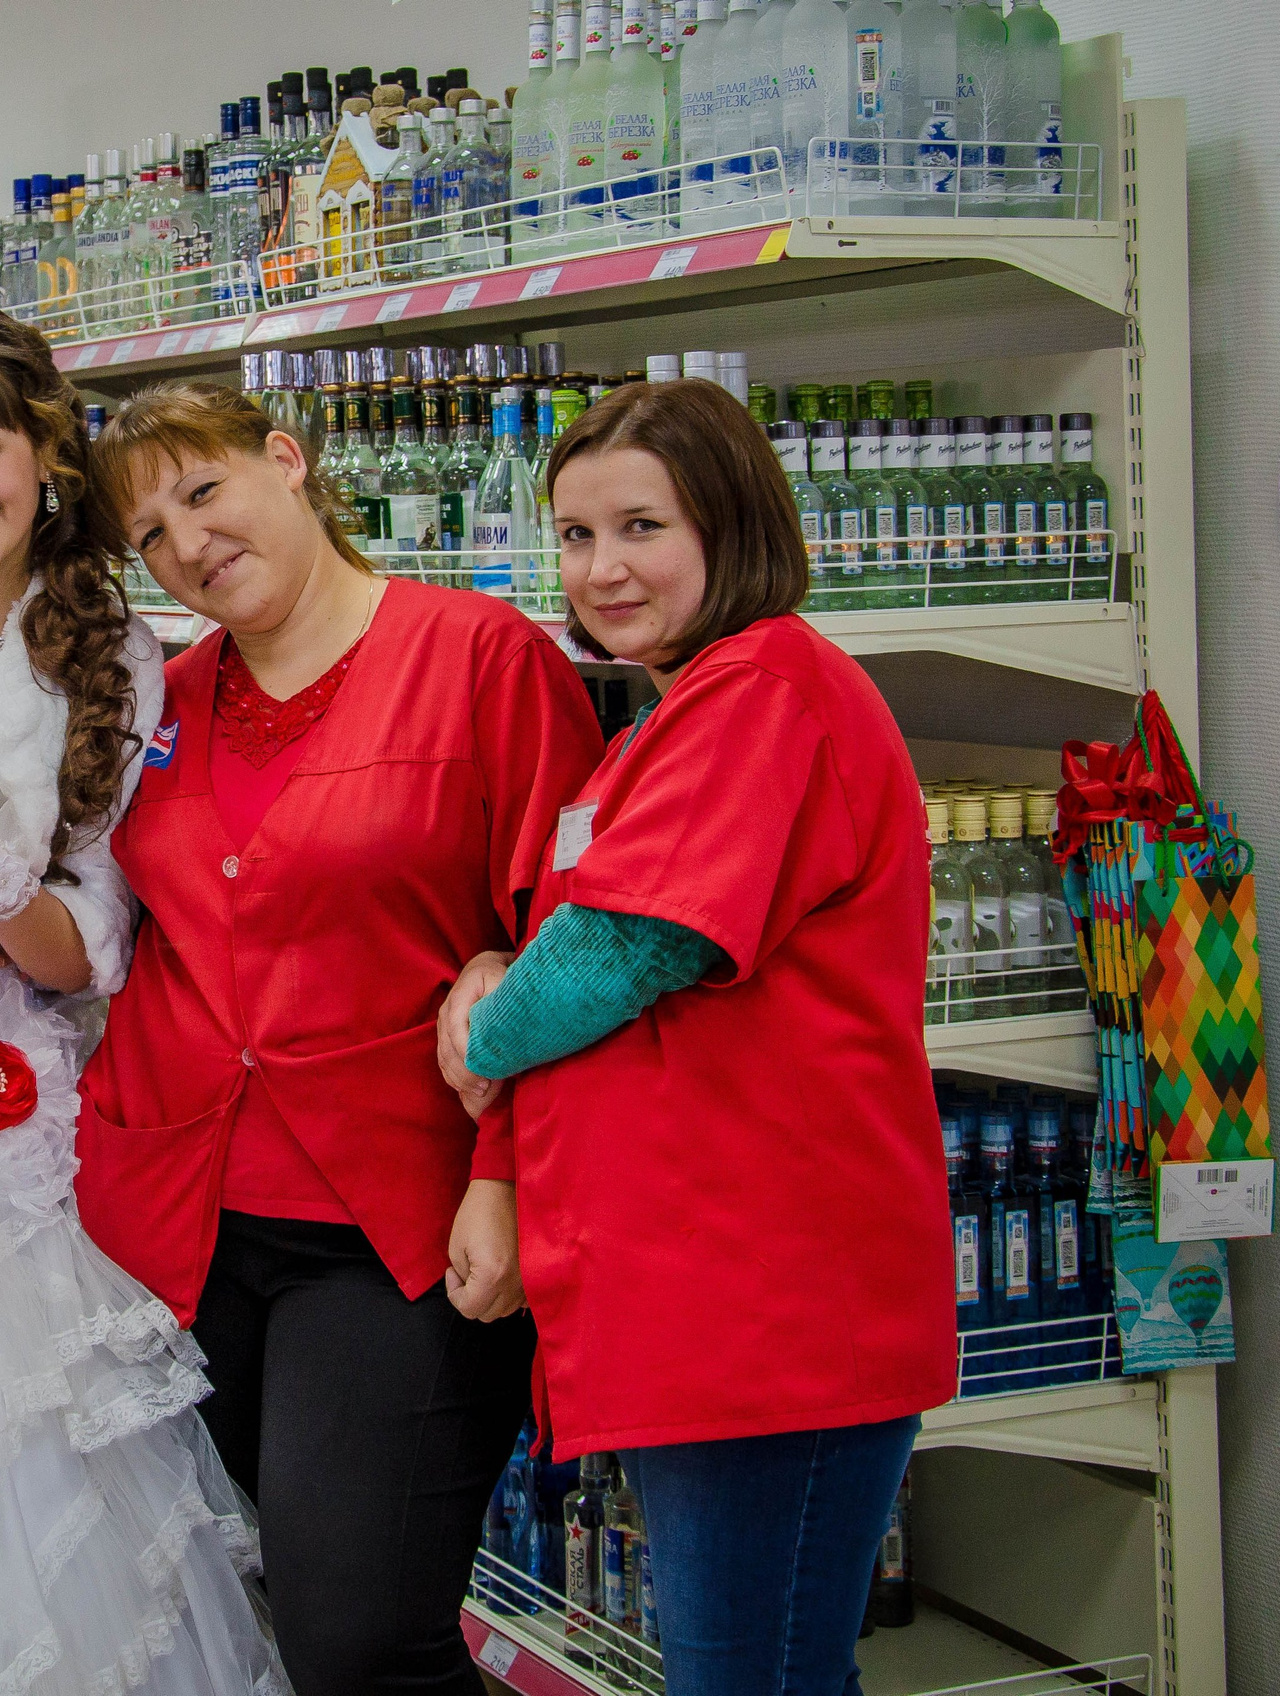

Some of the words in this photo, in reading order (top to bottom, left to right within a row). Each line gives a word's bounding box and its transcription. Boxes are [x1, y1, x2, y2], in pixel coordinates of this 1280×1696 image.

[615, 114, 648, 125] БЕЛАЯ
[608, 125, 656, 139] БЕРЕЗКА
[576, 1547, 585, 1589] СТАЛЬ
